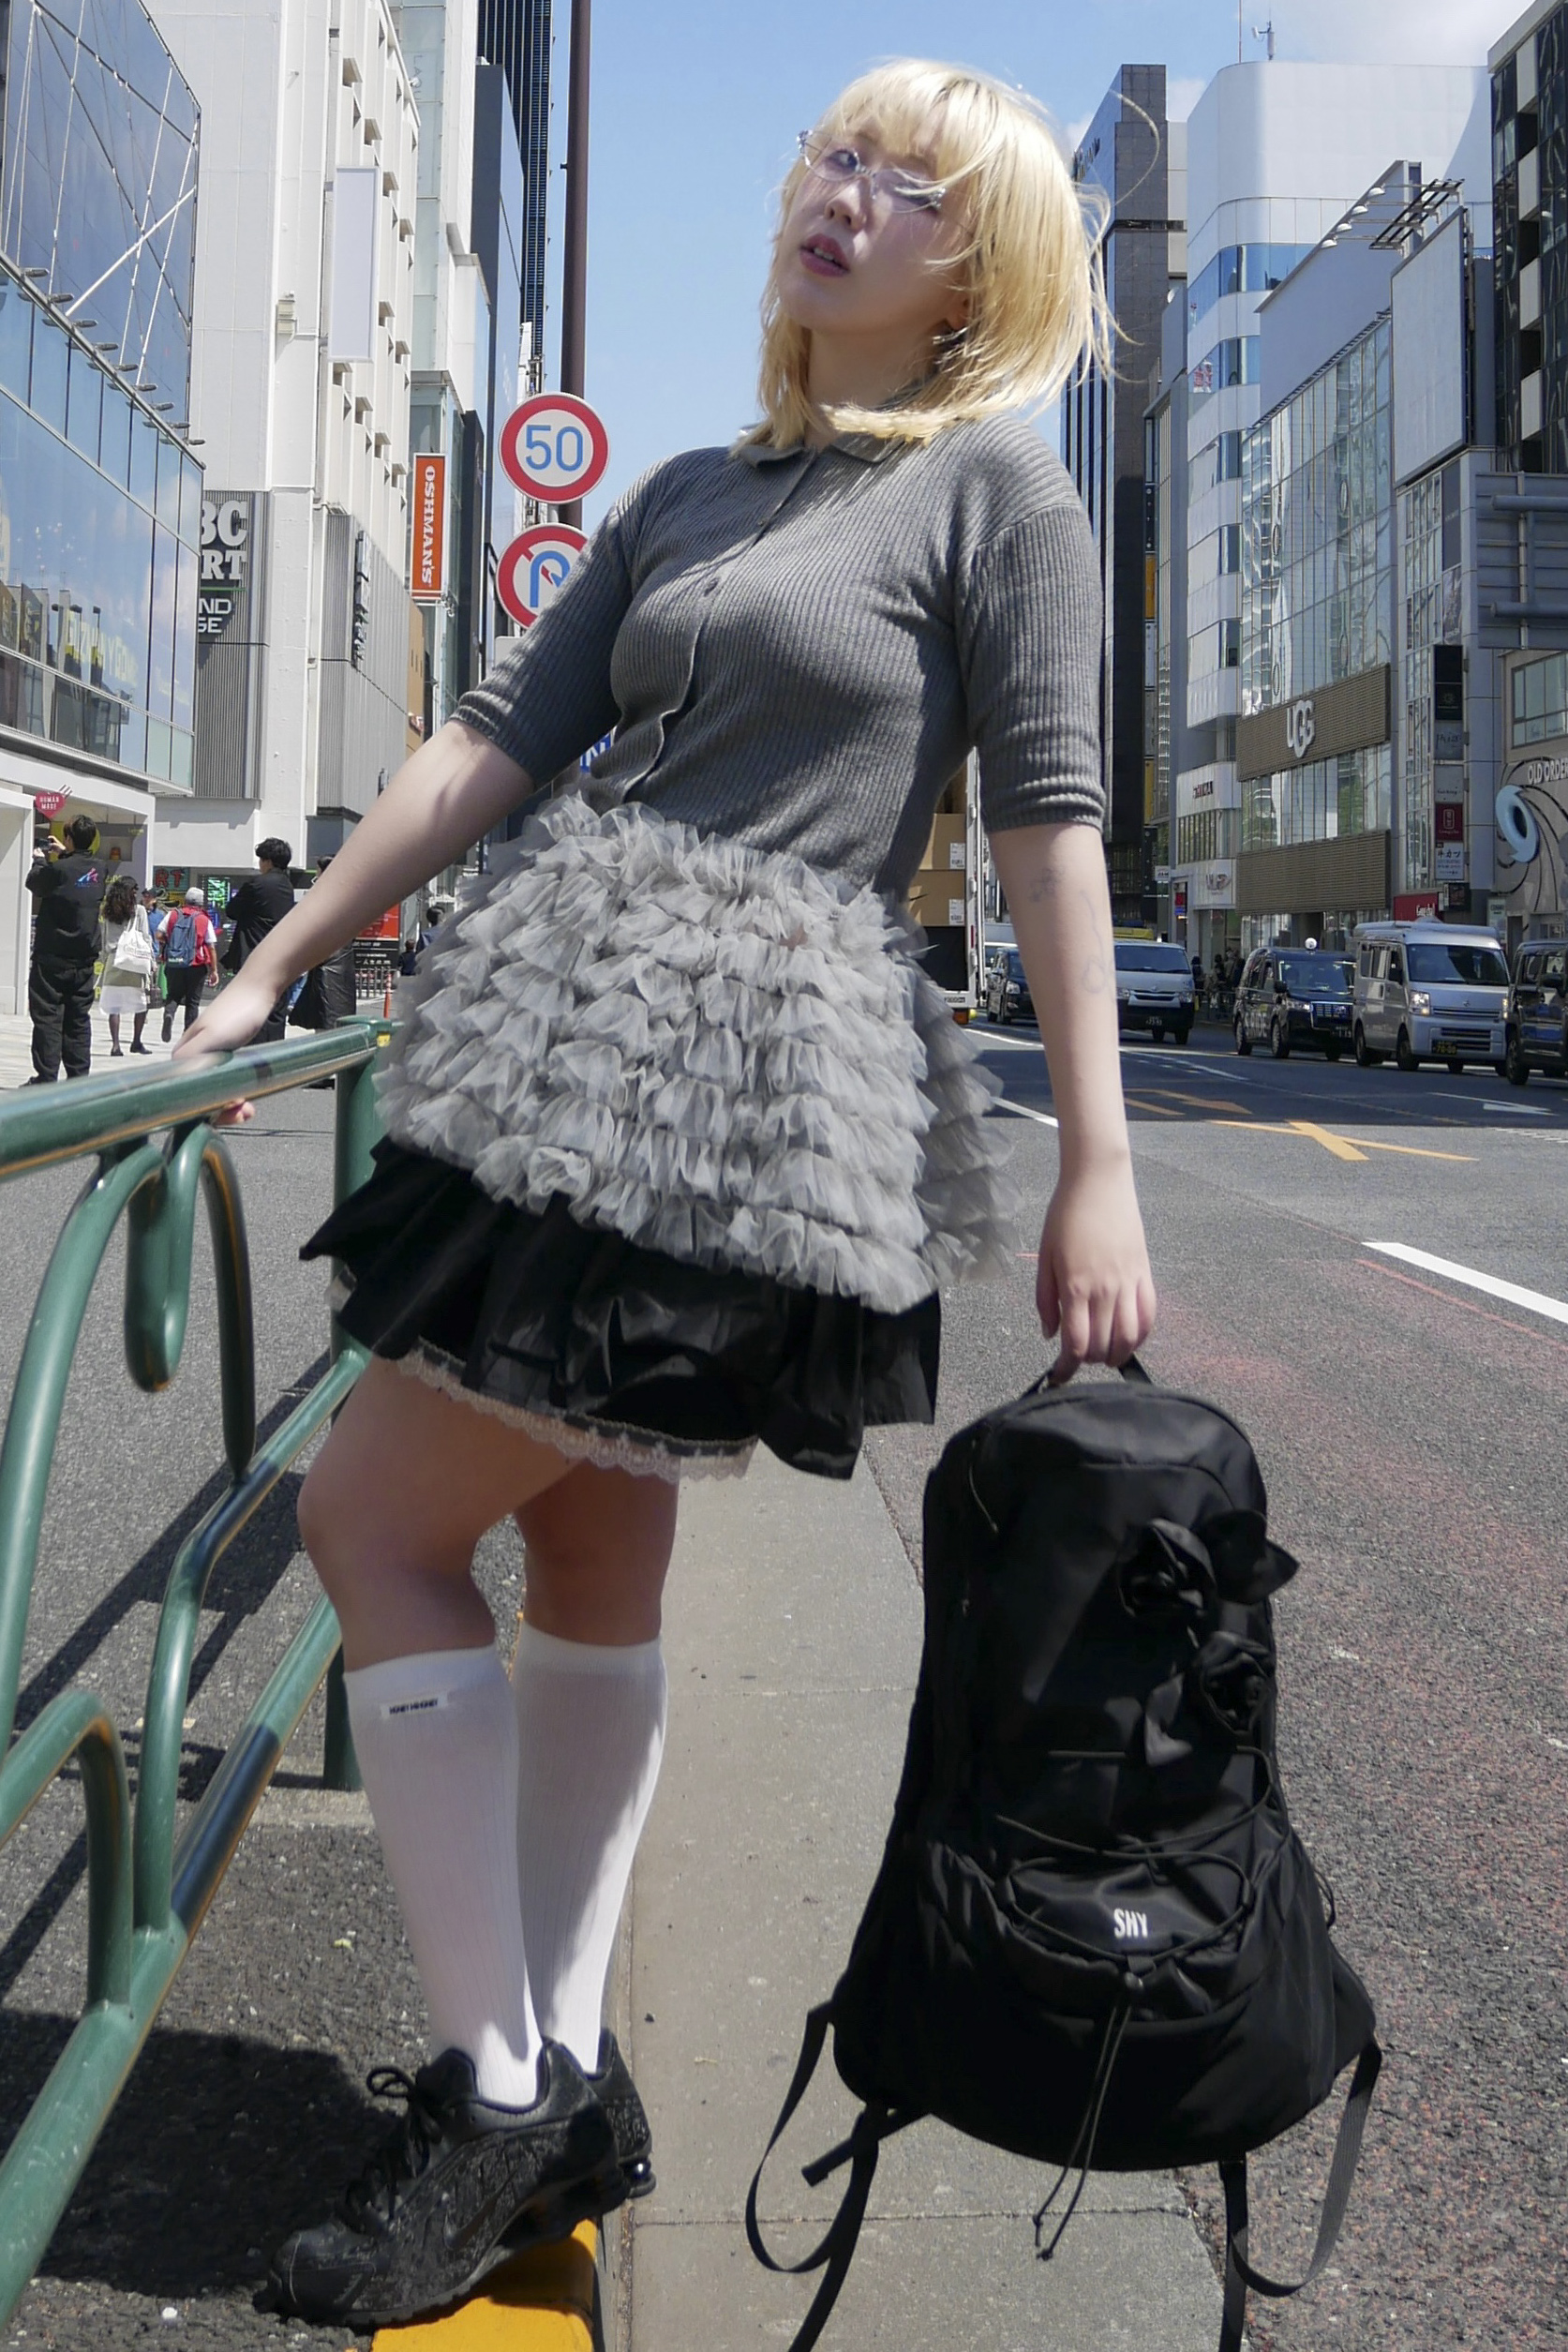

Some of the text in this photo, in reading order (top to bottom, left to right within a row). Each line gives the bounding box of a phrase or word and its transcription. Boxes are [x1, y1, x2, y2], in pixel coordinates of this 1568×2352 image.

[526, 425, 583, 472] 50
[422, 465, 436, 584] OSHMAN'S
[1287, 699, 1315, 758] UGG
[1528, 762, 1543, 785] OLD
